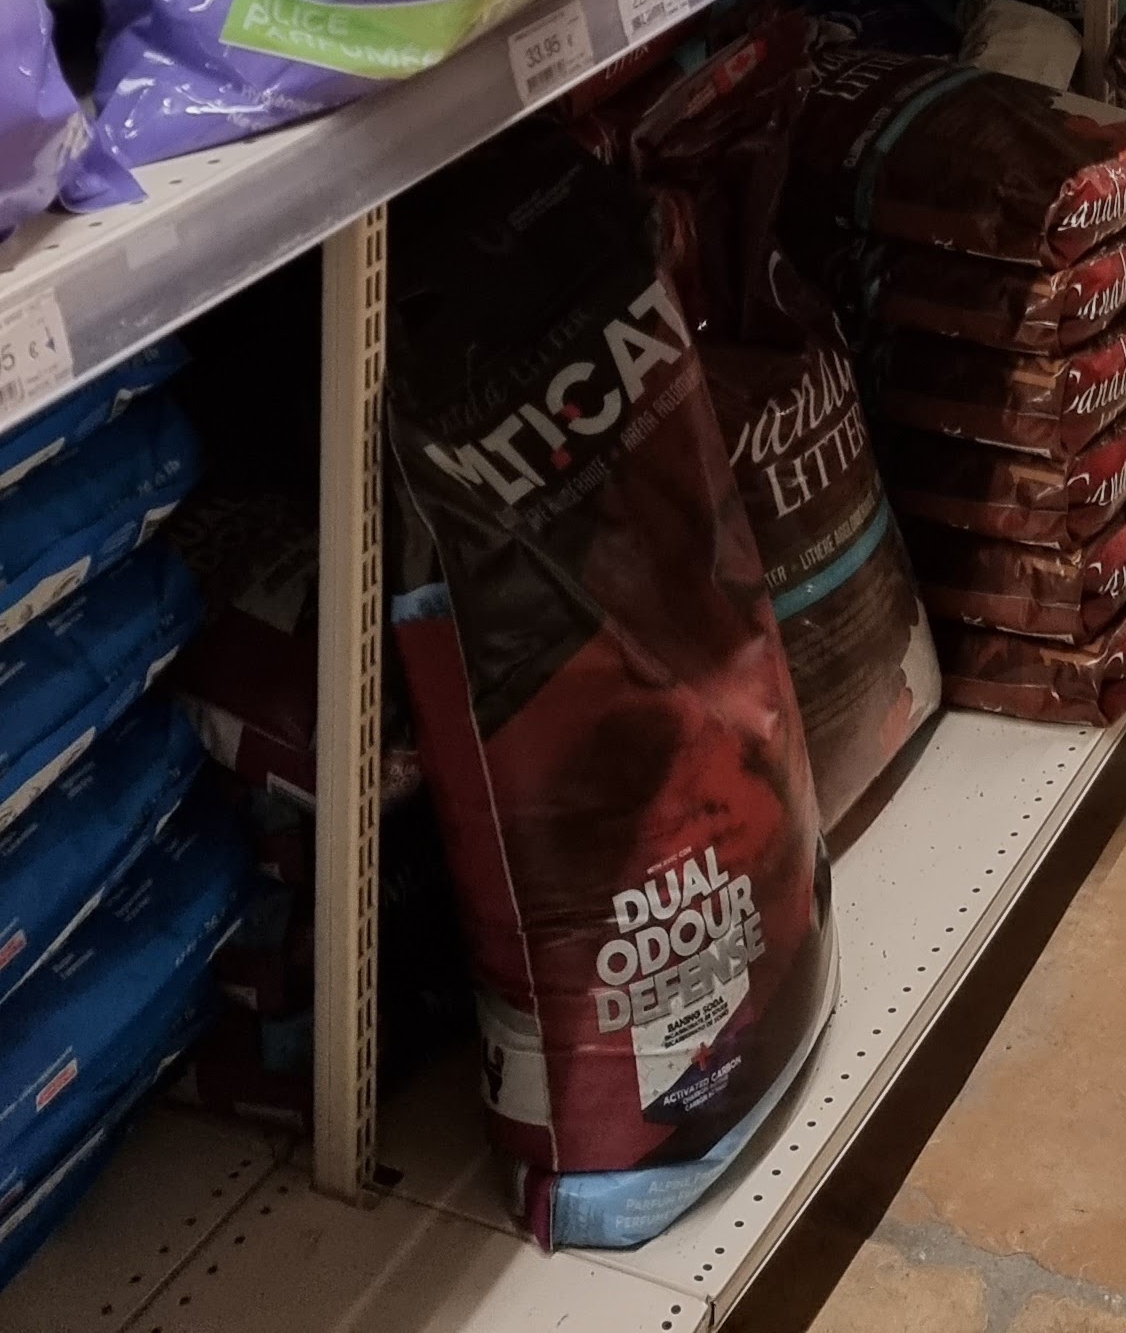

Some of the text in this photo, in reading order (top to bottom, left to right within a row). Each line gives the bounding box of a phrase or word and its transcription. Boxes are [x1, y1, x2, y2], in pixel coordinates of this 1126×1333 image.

[766, 402, 866, 519] LITTER
[596, 874, 755, 986] ODOUR
[612, 846, 729, 934] DUAL
[594, 911, 765, 1035] DEFENSE
[667, 996, 724, 1033] BAKING SODA
[663, 1055, 742, 1106] ACTIVATED CARBON
